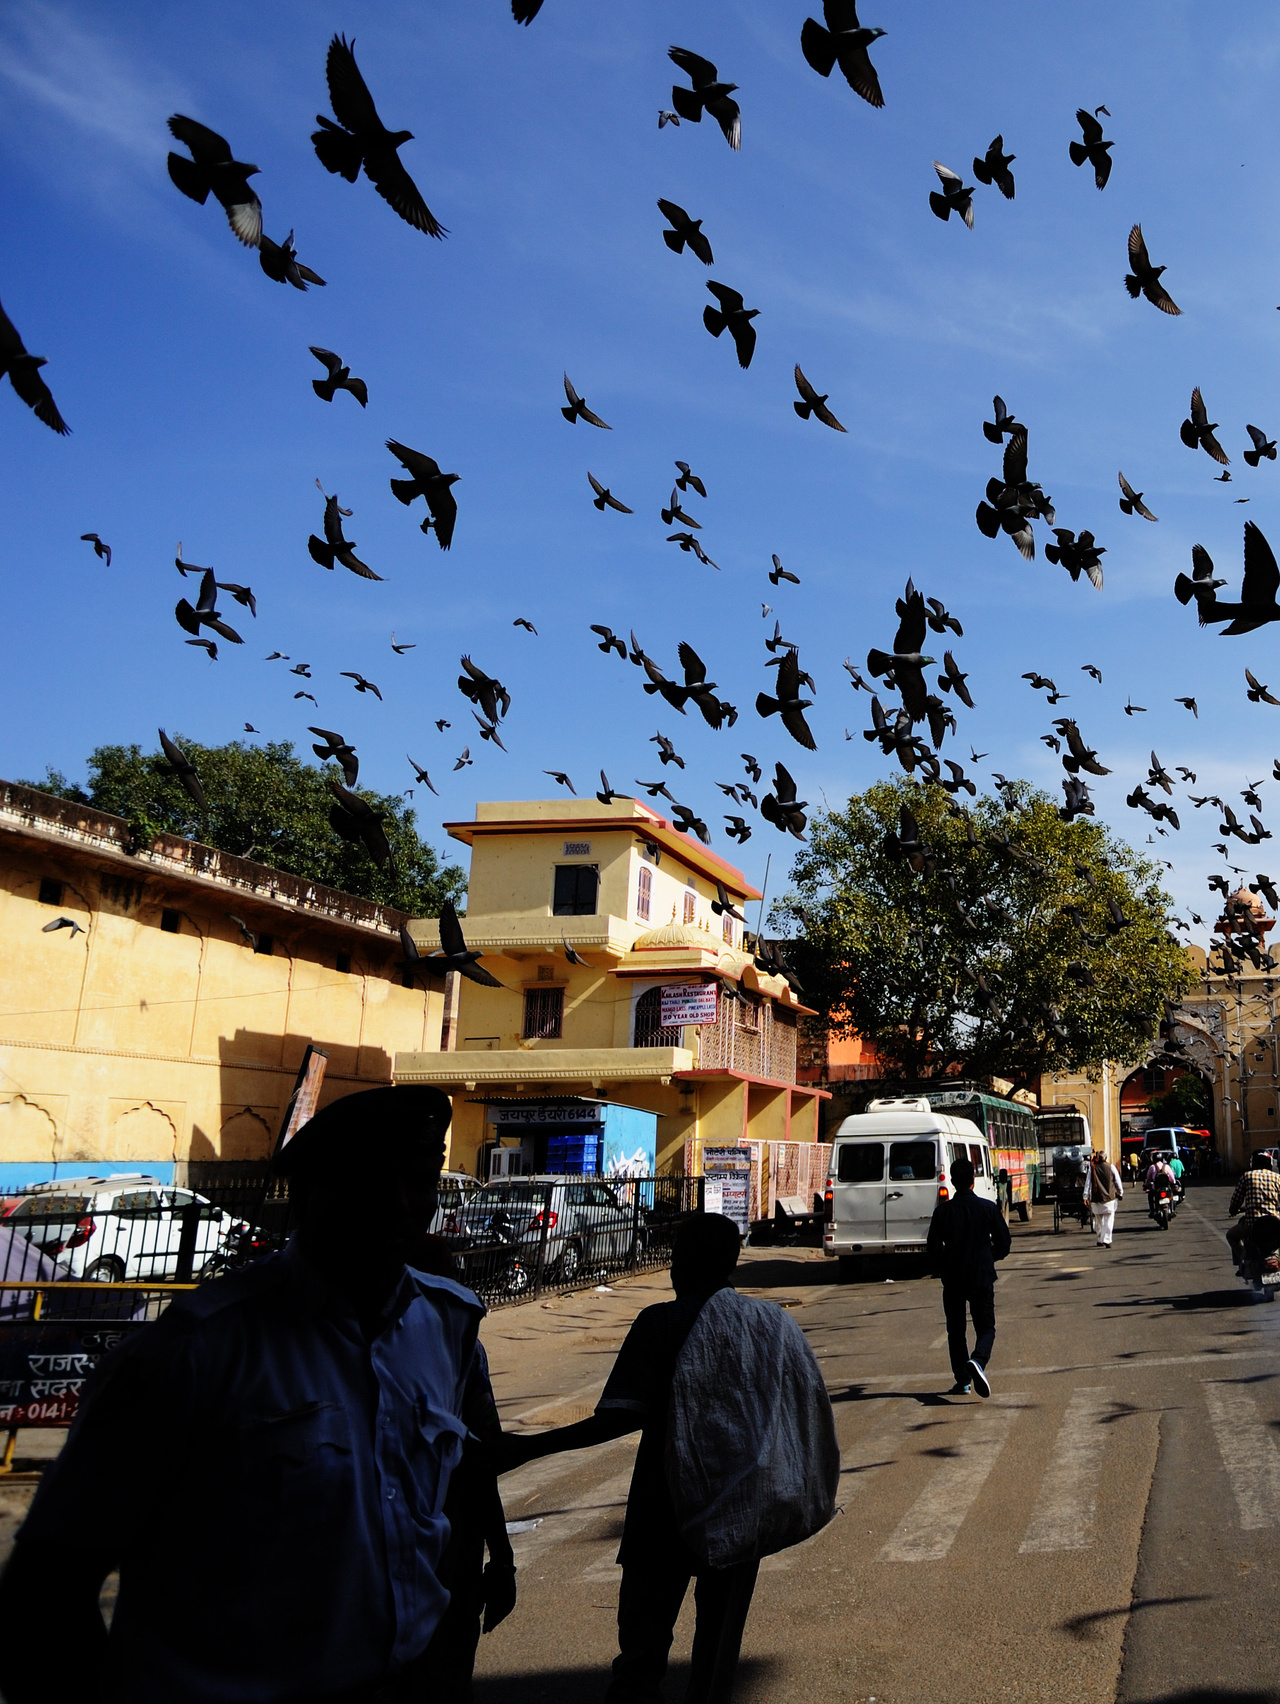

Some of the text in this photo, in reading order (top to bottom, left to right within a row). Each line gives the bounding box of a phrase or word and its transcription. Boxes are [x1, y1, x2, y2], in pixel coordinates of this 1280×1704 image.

[661, 989, 683, 999] KAILASH
[682, 987, 717, 998] RESTAURANT
[499, 1108, 537, 1123] जयपुर
[567, 1108, 596, 1120] 6144
[28, 1402, 79, 1419] 0141-2
